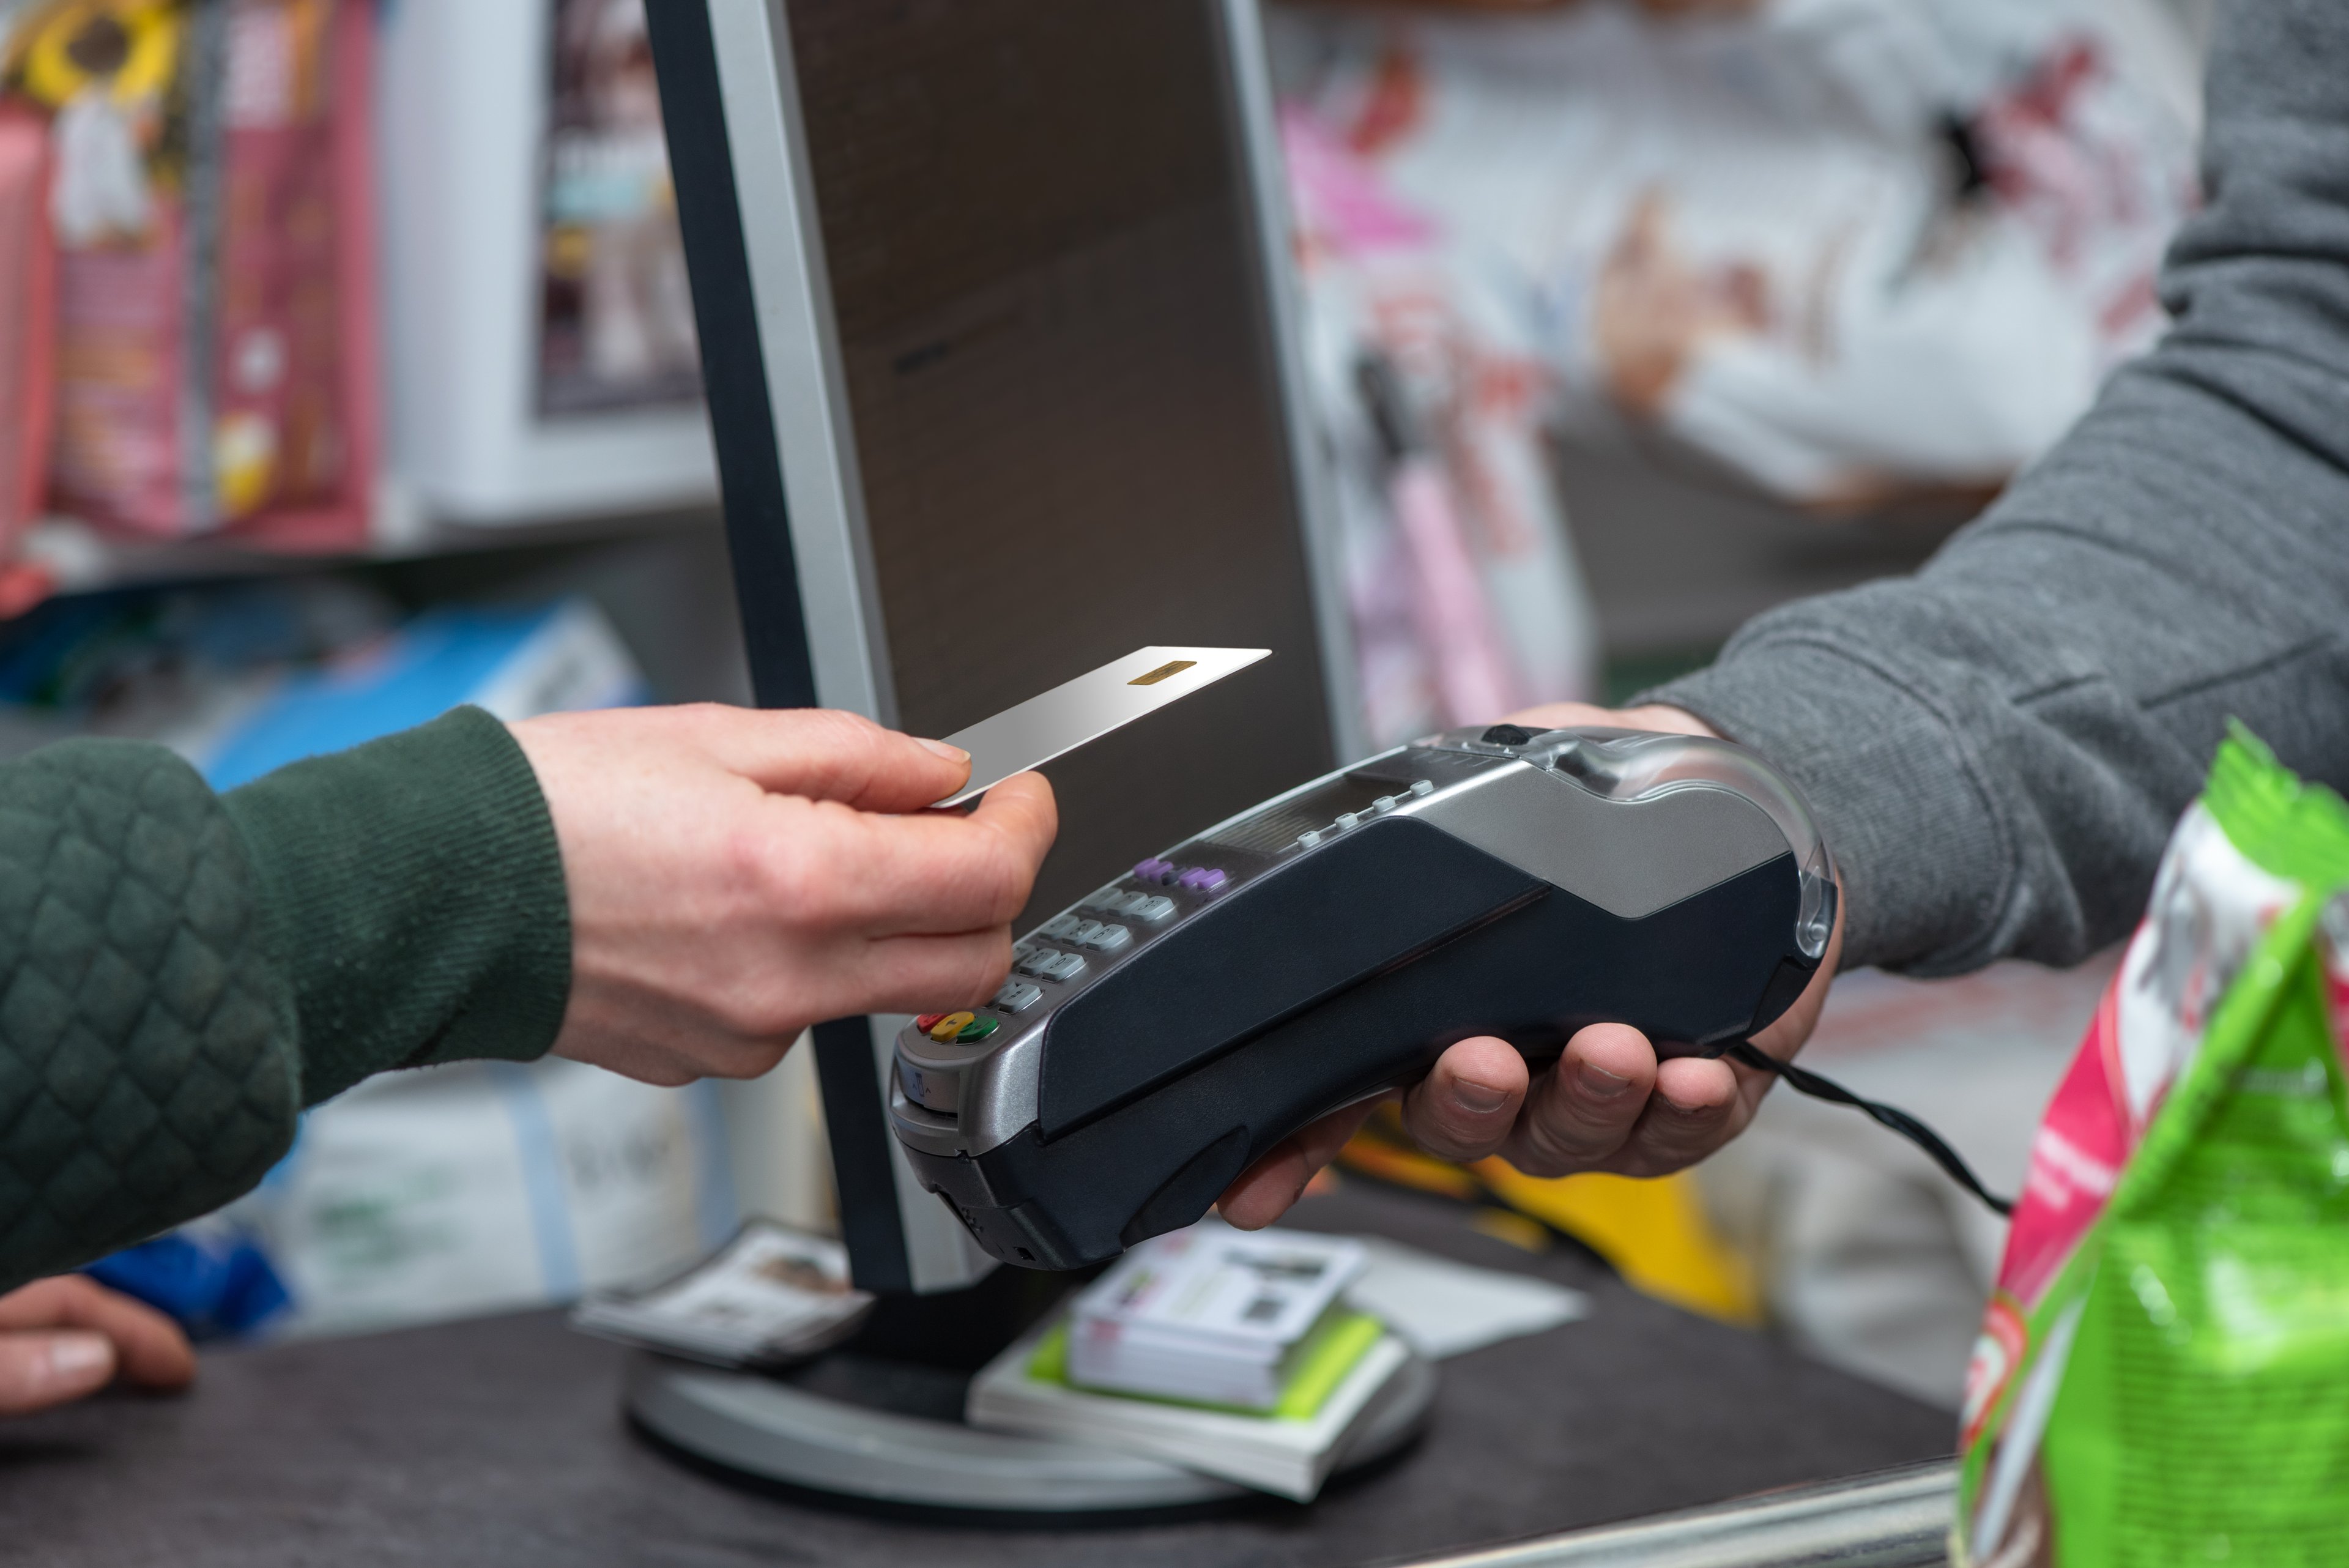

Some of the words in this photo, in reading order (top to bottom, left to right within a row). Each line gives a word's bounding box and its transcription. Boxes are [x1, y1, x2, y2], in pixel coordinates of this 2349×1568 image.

[1137, 900, 1155, 911] 3
[1093, 928, 1110, 939] 6
[1049, 957, 1067, 969] 9
